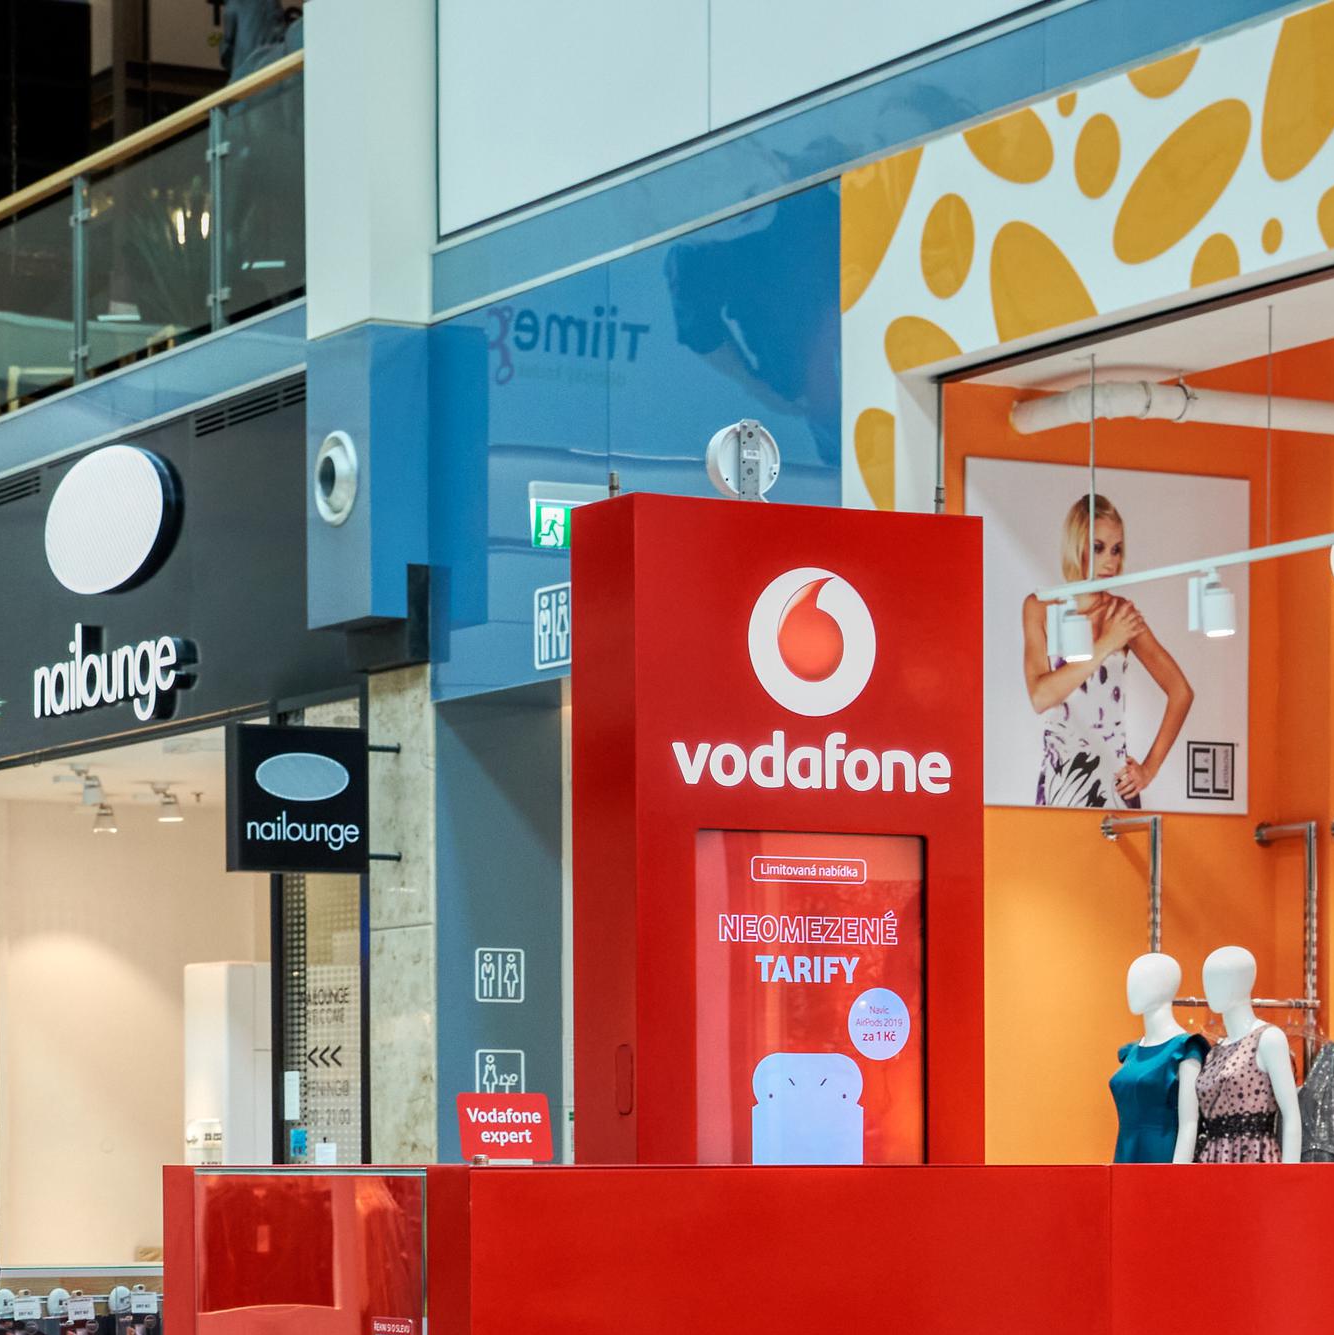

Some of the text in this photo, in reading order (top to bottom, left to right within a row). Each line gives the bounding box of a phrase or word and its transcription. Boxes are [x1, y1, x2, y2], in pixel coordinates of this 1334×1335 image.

[33, 622, 177, 721] nailounge
[671, 730, 952, 794] vodafone
[246, 810, 360, 851] nailounge
[760, 863, 858, 878] Limitovaná nabídka
[718, 910, 898, 946] NEOMEZENÉ
[755, 955, 860, 984] TARIFY
[883, 1016, 903, 1028] 2019
[862, 1032, 875, 1042] za
[883, 1029, 896, 1042] Kč
[466, 1107, 542, 1124] Vodafone
[480, 1129, 534, 1147] expert
